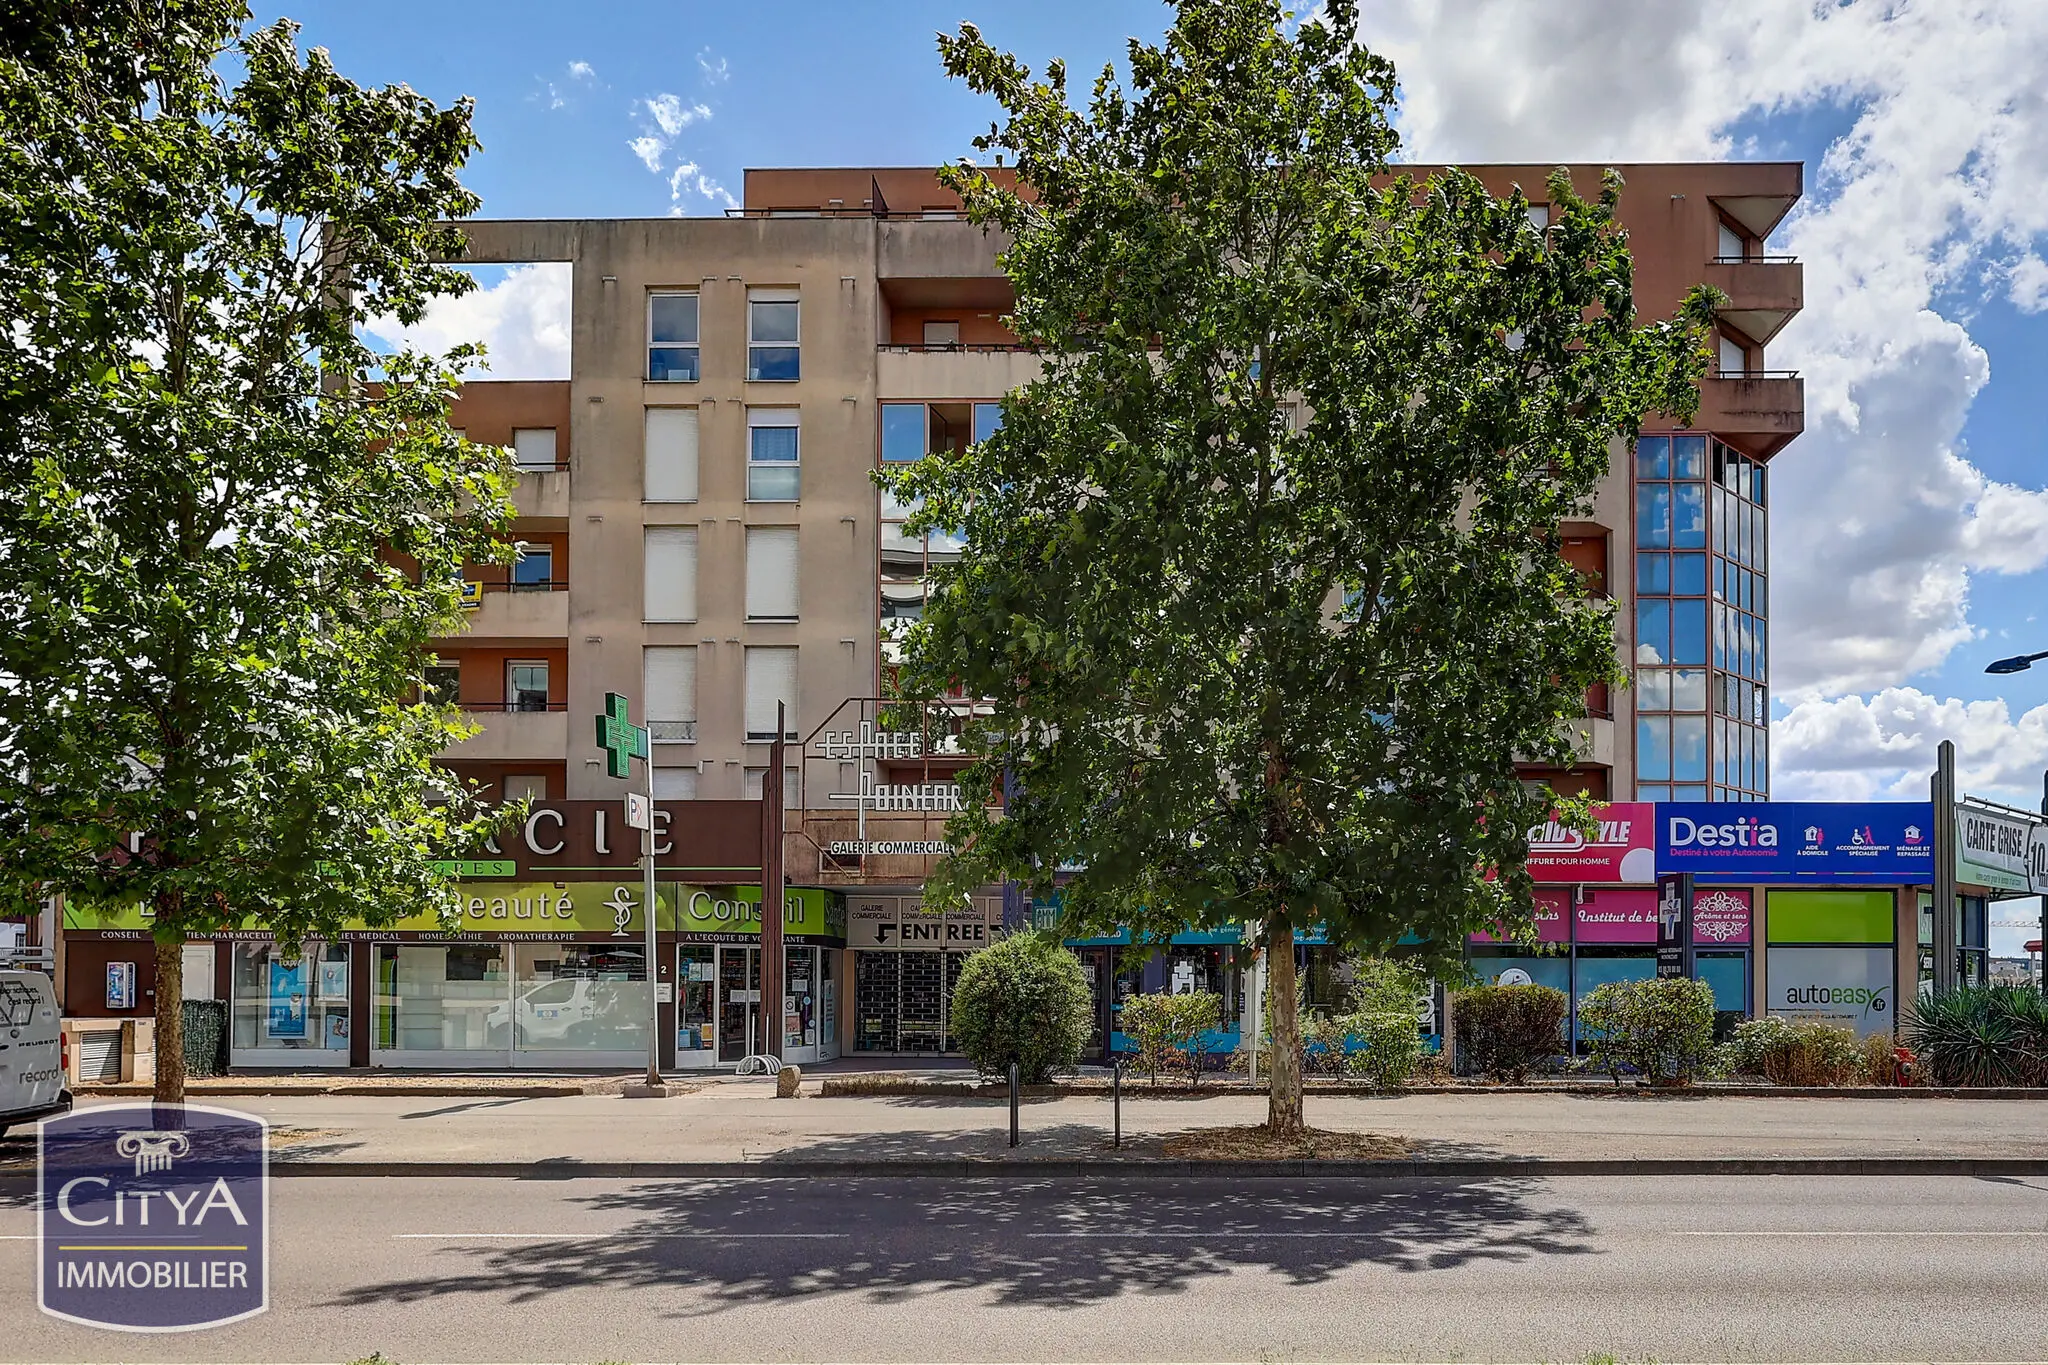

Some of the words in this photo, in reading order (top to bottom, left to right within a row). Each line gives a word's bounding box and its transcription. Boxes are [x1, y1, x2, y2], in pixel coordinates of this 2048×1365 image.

[816, 720, 920, 760] ESPACE
[829, 771, 970, 841] POINCAR
[1670, 817, 1778, 847] Destia
[1966, 818, 1995, 853] CARTE
[1998, 825, 2023, 858] GRISE
[832, 842, 873, 854] GALERIE
[877, 842, 955, 854] COMMERCIALE
[1670, 848, 1701, 857] Destiné
[1711, 849, 1731, 857] votre
[1733, 848, 1778, 857] Autonomie
[688, 891, 805, 923] Consil
[860, 904, 884, 912] GALERIE
[852, 912, 893, 920] COMMERCIALE
[1578, 910, 1625, 923] Institut
[1629, 910, 1642, 923] de
[1646, 910, 1658, 923] be
[1732, 912, 1747, 920] sens
[101, 931, 141, 939] CONSEIL
[209, 931, 277, 940] PHARMACEUTI
[357, 932, 401, 941] MEDICAL
[418, 932, 483, 941] HOMEPATHIE
[497, 932, 575, 941] AROMATHERAPIE
[902, 923, 984, 941] ENTREE
[694, 934, 736, 942] L'ECOUTE
[784, 935, 806, 944] ANTE
[660, 965, 667, 974] 2
[19, 1038, 59, 1047] PEUGEOT
[19, 1063, 59, 1085] record
